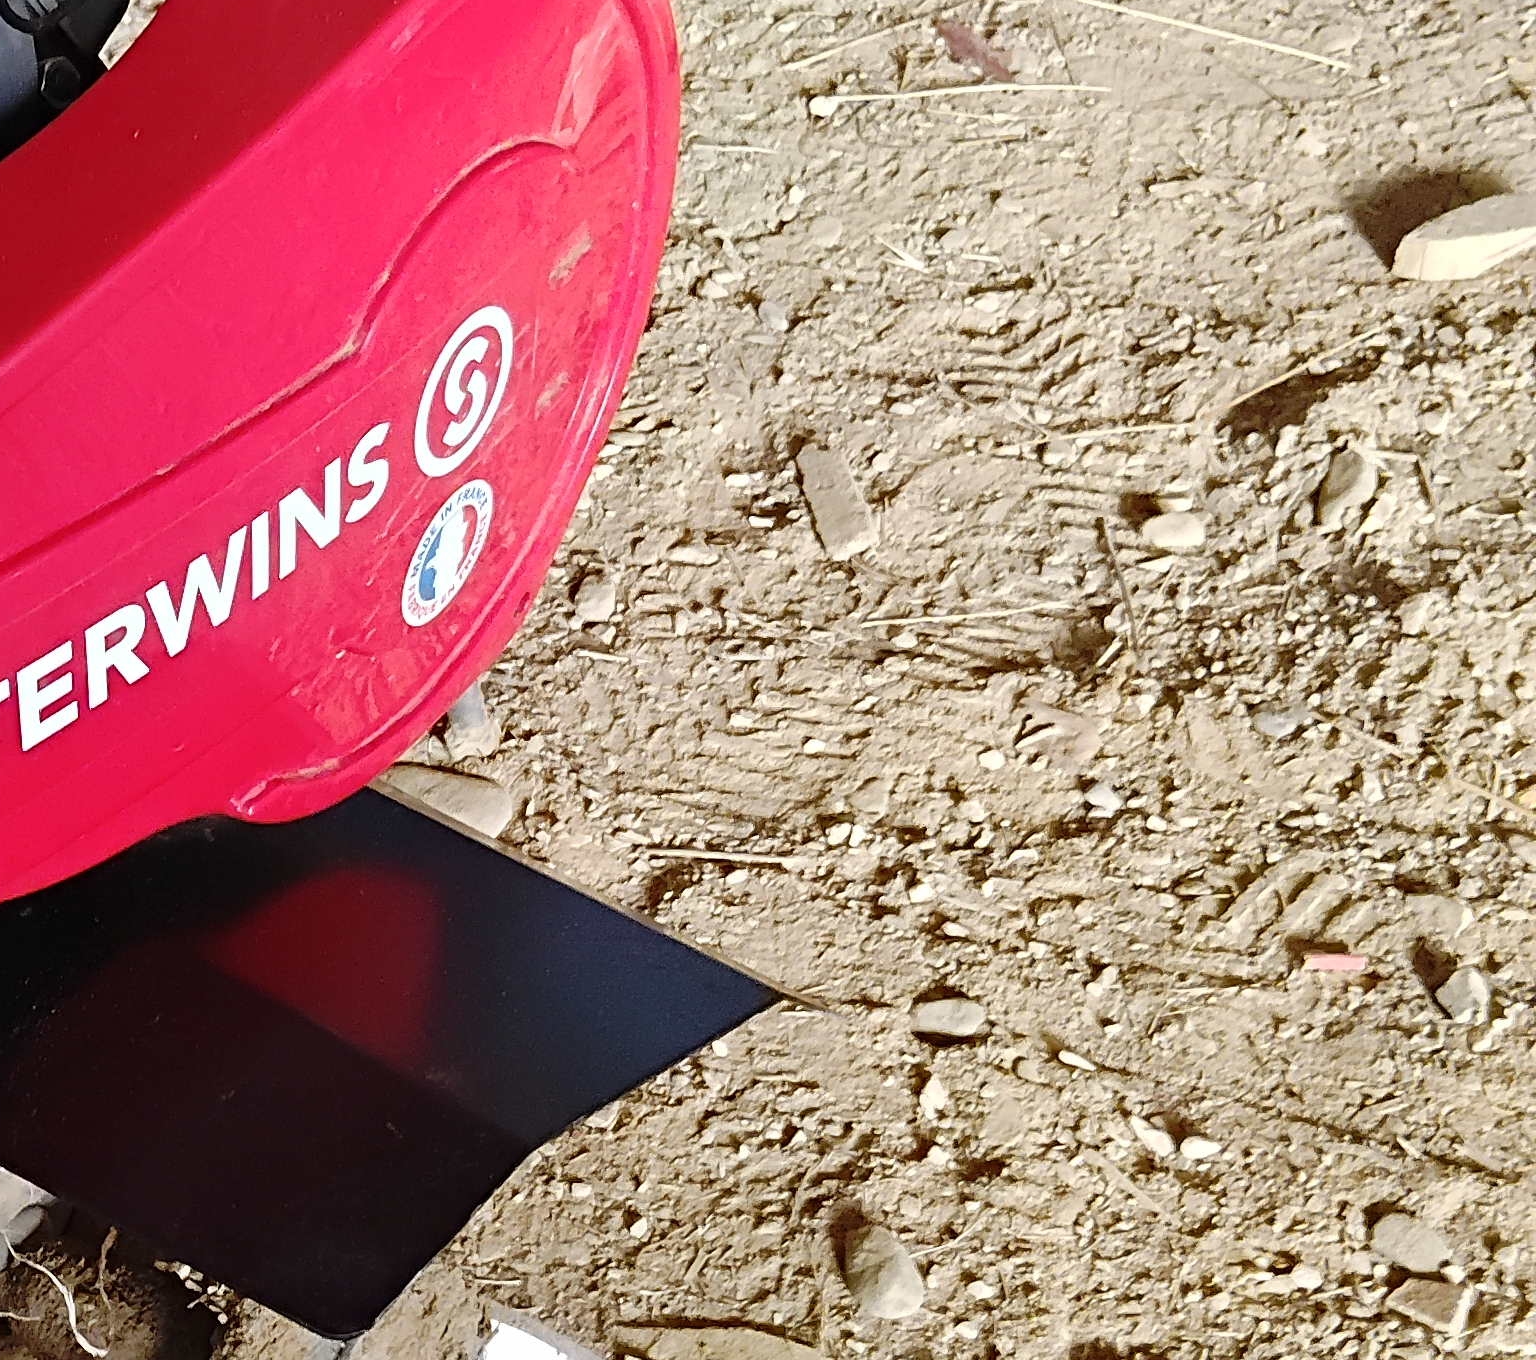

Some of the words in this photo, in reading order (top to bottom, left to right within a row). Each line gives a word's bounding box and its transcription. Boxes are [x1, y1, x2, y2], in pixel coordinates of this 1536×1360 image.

[410, 523, 438, 578] MADE
[440, 502, 452, 521] IN
[457, 487, 488, 511] FRANCE
